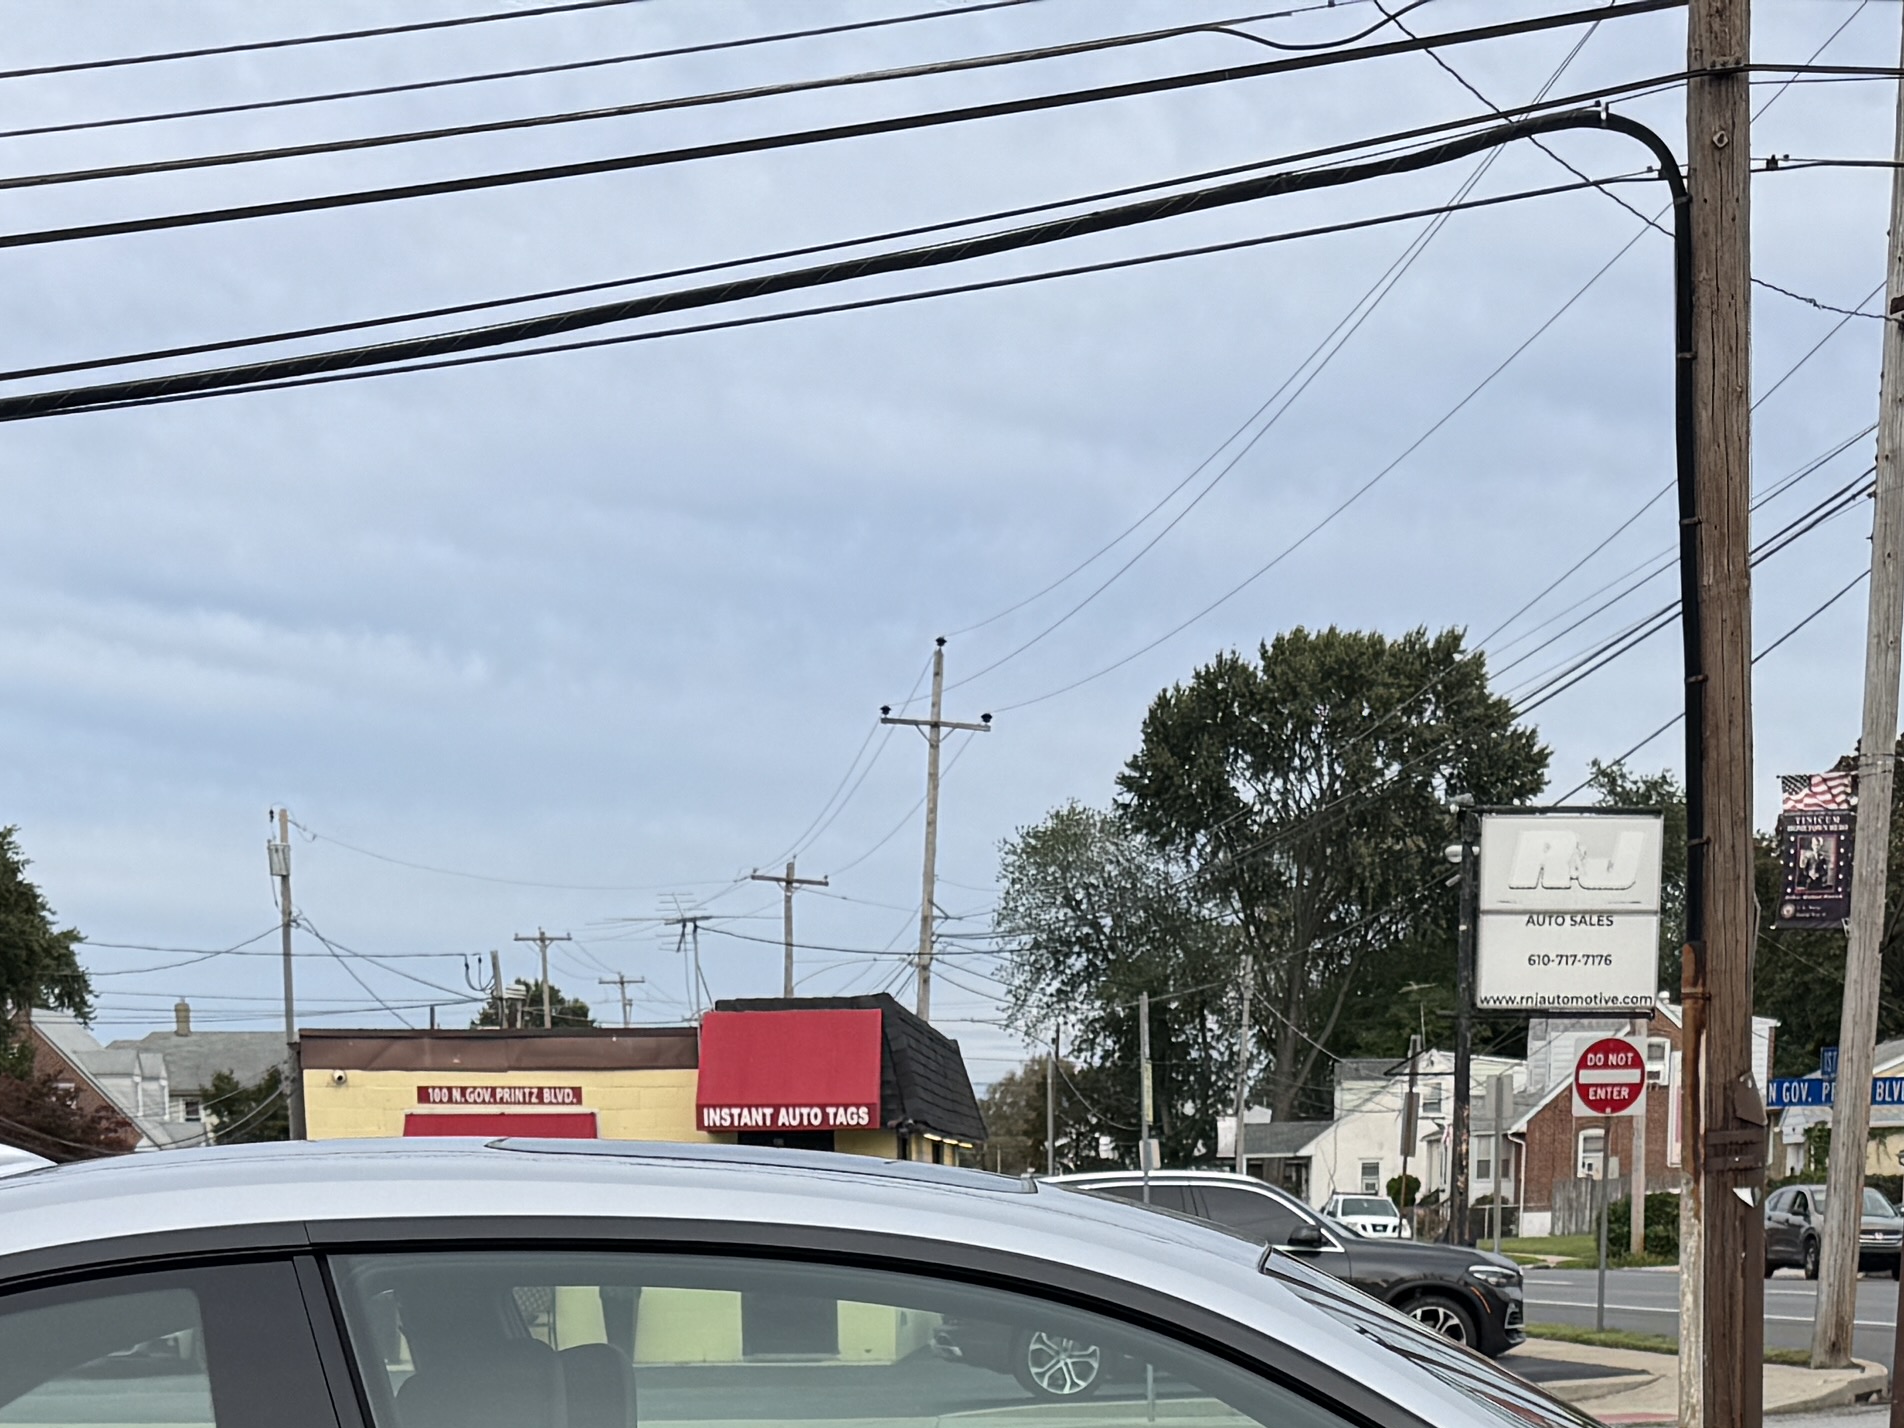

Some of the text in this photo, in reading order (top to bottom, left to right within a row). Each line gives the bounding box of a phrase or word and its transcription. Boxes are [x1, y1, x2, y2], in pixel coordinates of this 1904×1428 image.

[1525, 915, 1614, 926] AUTO SALES
[1527, 954, 1613, 966] 610-717-7176
[1587, 1053, 1634, 1066] DO NOT
[428, 1087, 448, 1103] 100
[496, 1087, 539, 1103] PRINTZ
[543, 1088, 577, 1103] BLVD.
[1589, 1087, 1629, 1100] ENTER
[1769, 1081, 1776, 1102] N
[1782, 1081, 1812, 1102] GOV.
[703, 1106, 869, 1127] INSTANT AUTO TAGS
